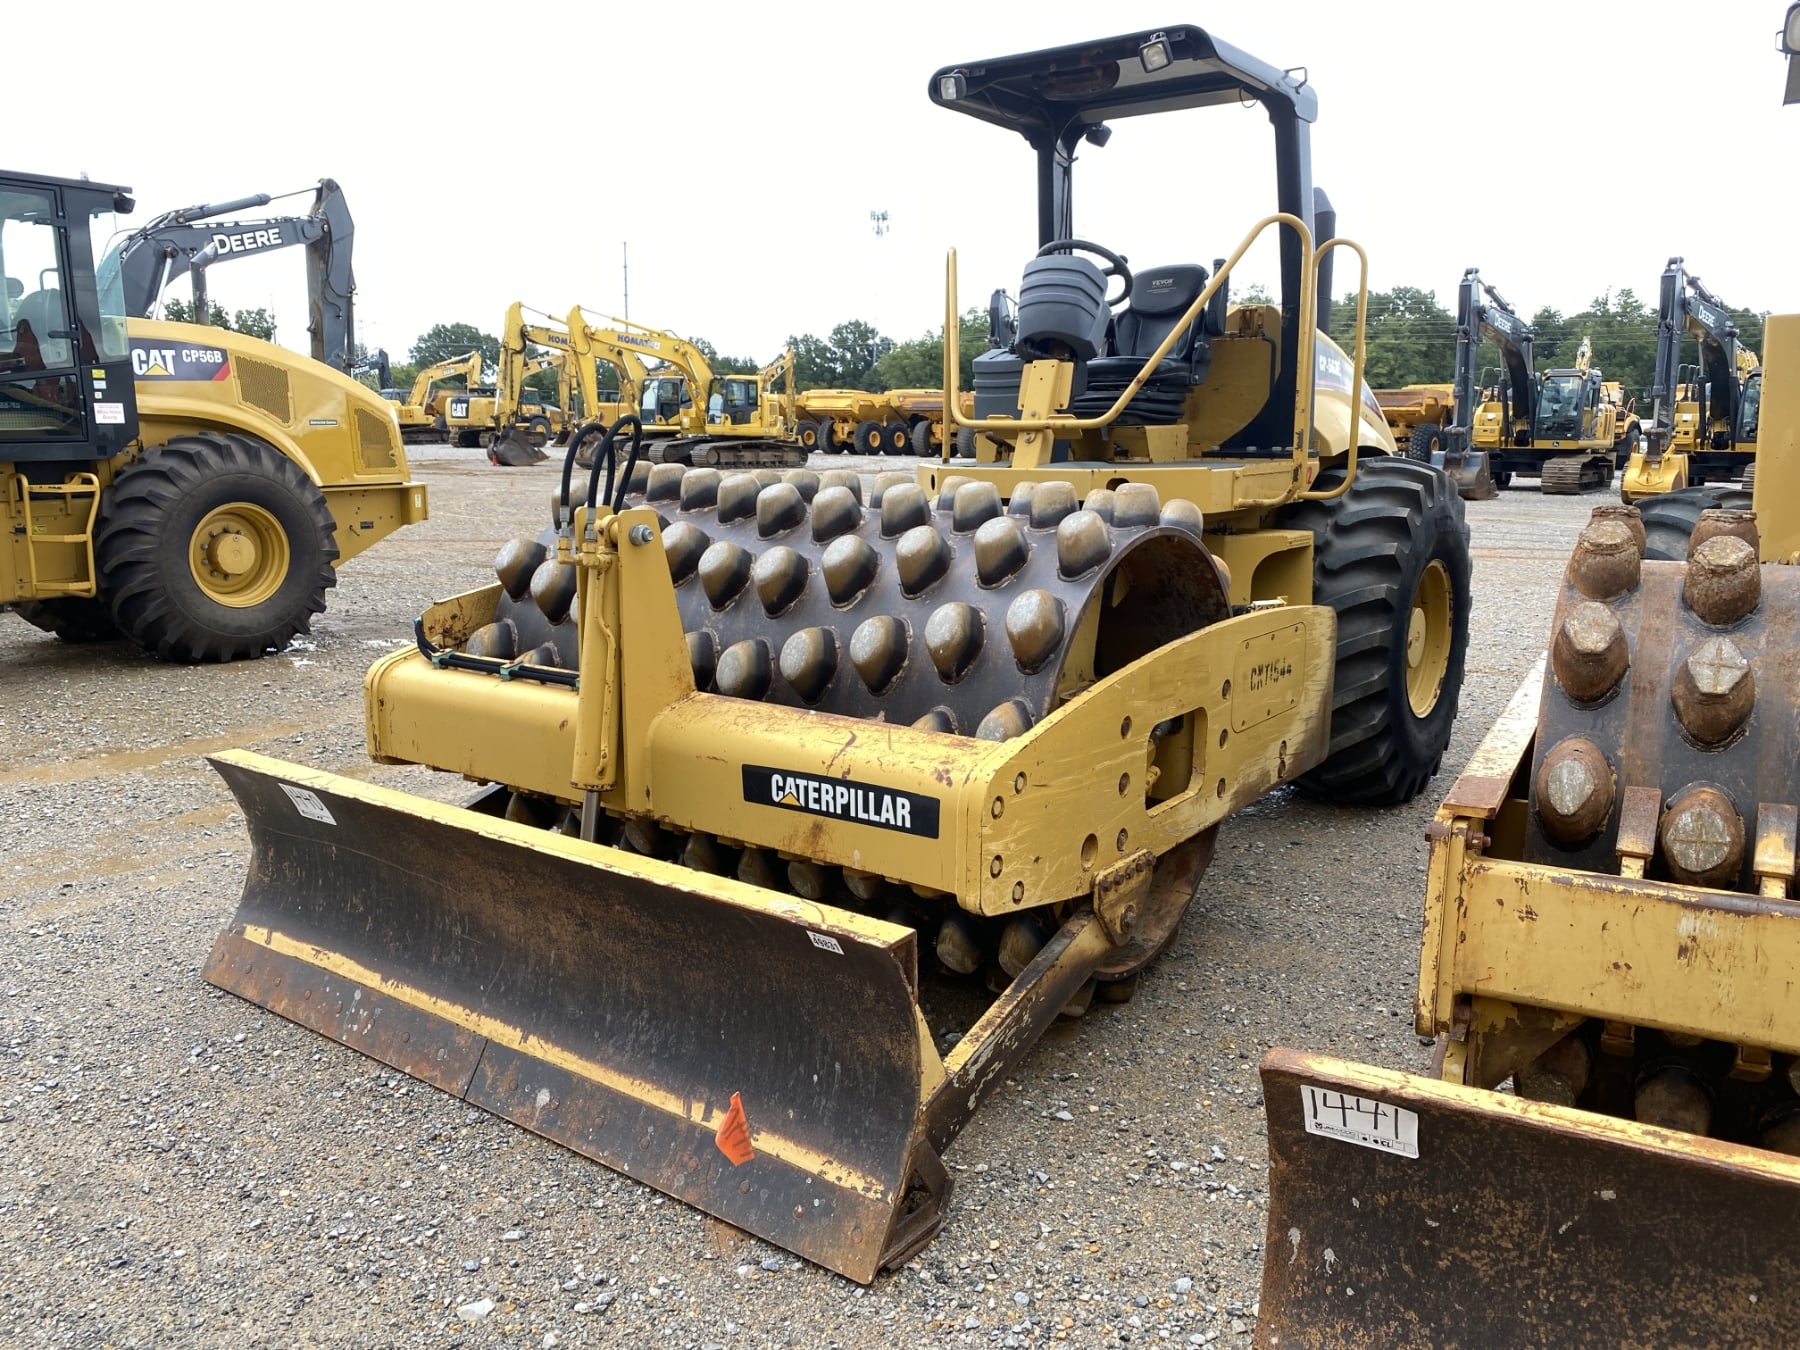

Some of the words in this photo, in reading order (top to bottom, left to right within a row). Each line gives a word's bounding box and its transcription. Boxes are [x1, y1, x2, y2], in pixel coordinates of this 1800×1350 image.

[212, 227, 282, 255] DEERE
[1494, 312, 1512, 334] DEERE
[1699, 304, 1715, 328] DEERE
[131, 348, 176, 376] CAT
[181, 349, 223, 363] CP56B
[451, 402, 468, 417] CAT
[771, 773, 911, 829] CATERPILLAR
[1311, 1088, 1399, 1140] 1441
